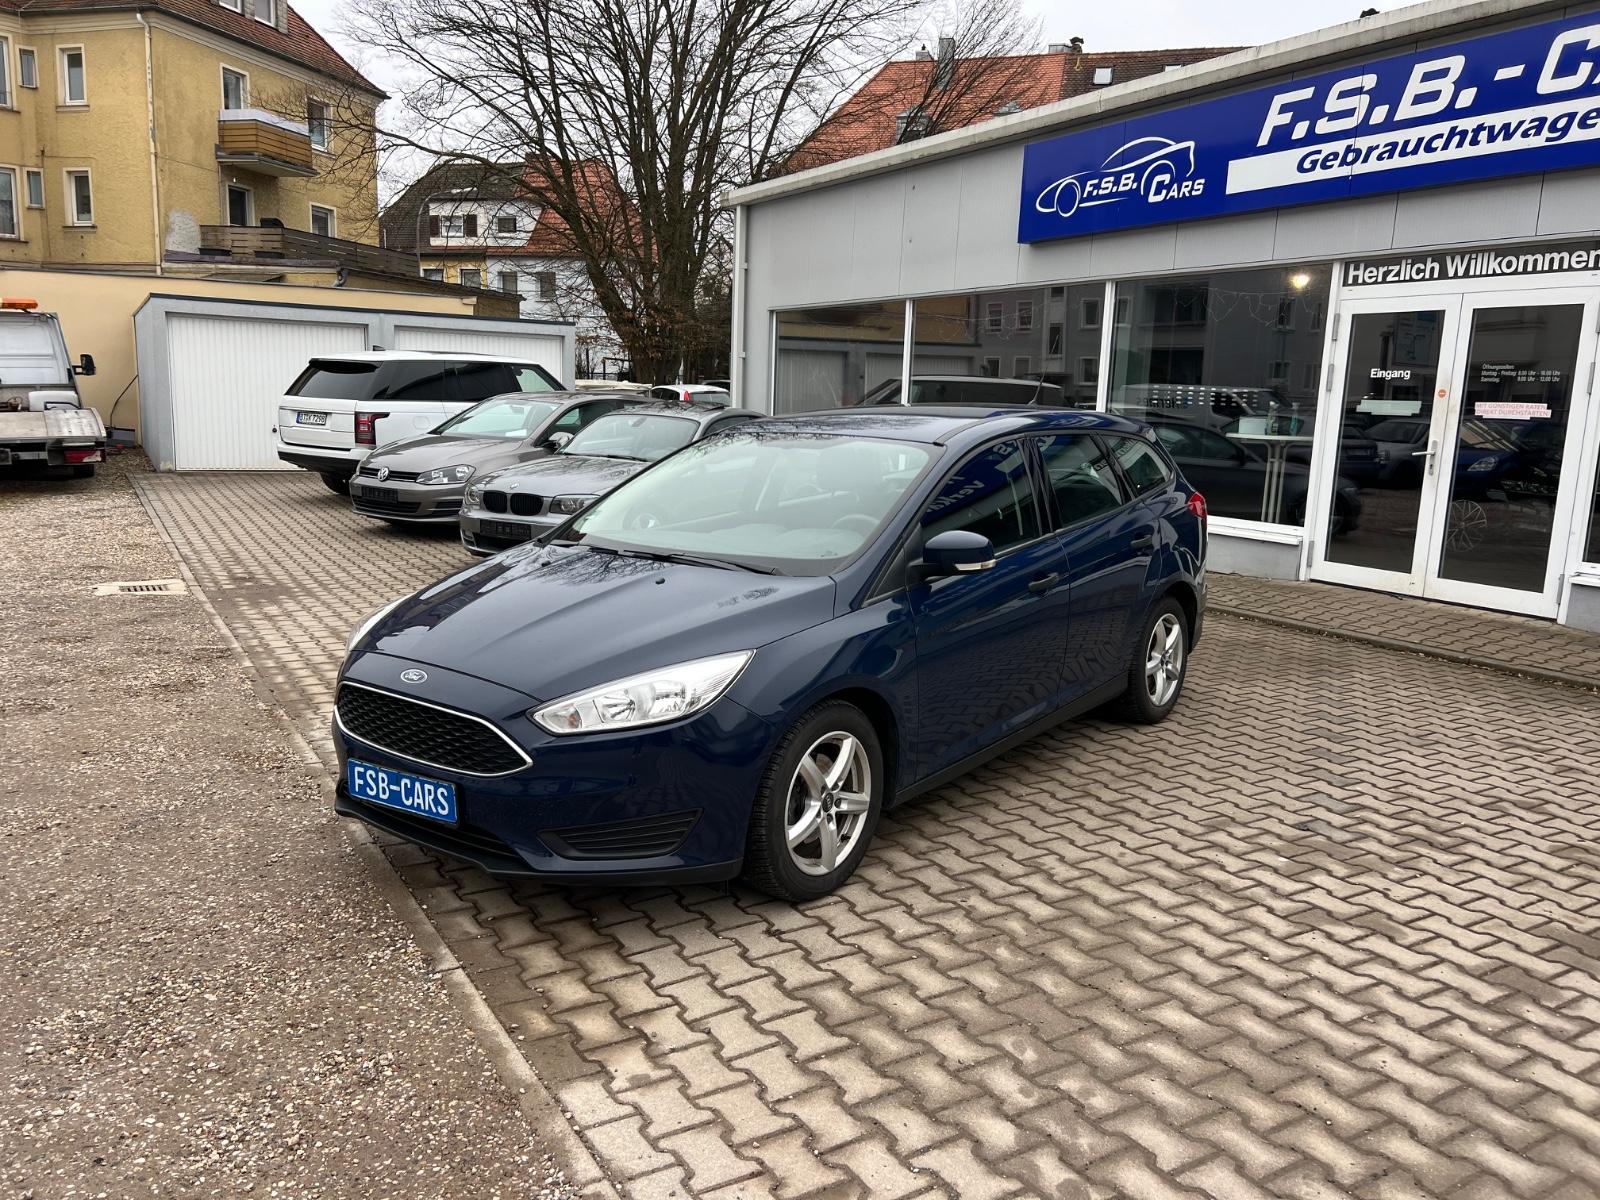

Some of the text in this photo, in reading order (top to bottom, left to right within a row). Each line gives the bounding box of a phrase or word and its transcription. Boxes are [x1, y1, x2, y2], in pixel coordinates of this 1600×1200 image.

[1256, 55, 1478, 148] F.S.B.
[1536, 24, 1600, 95] C
[1296, 107, 1600, 174] Gebrauchtwage
[1082, 172, 1138, 198] F.S.B.
[1347, 249, 1600, 284] Herzlich Willkommen
[1370, 368, 1411, 380] Eingang
[354, 767, 450, 816] FSB-CARS
